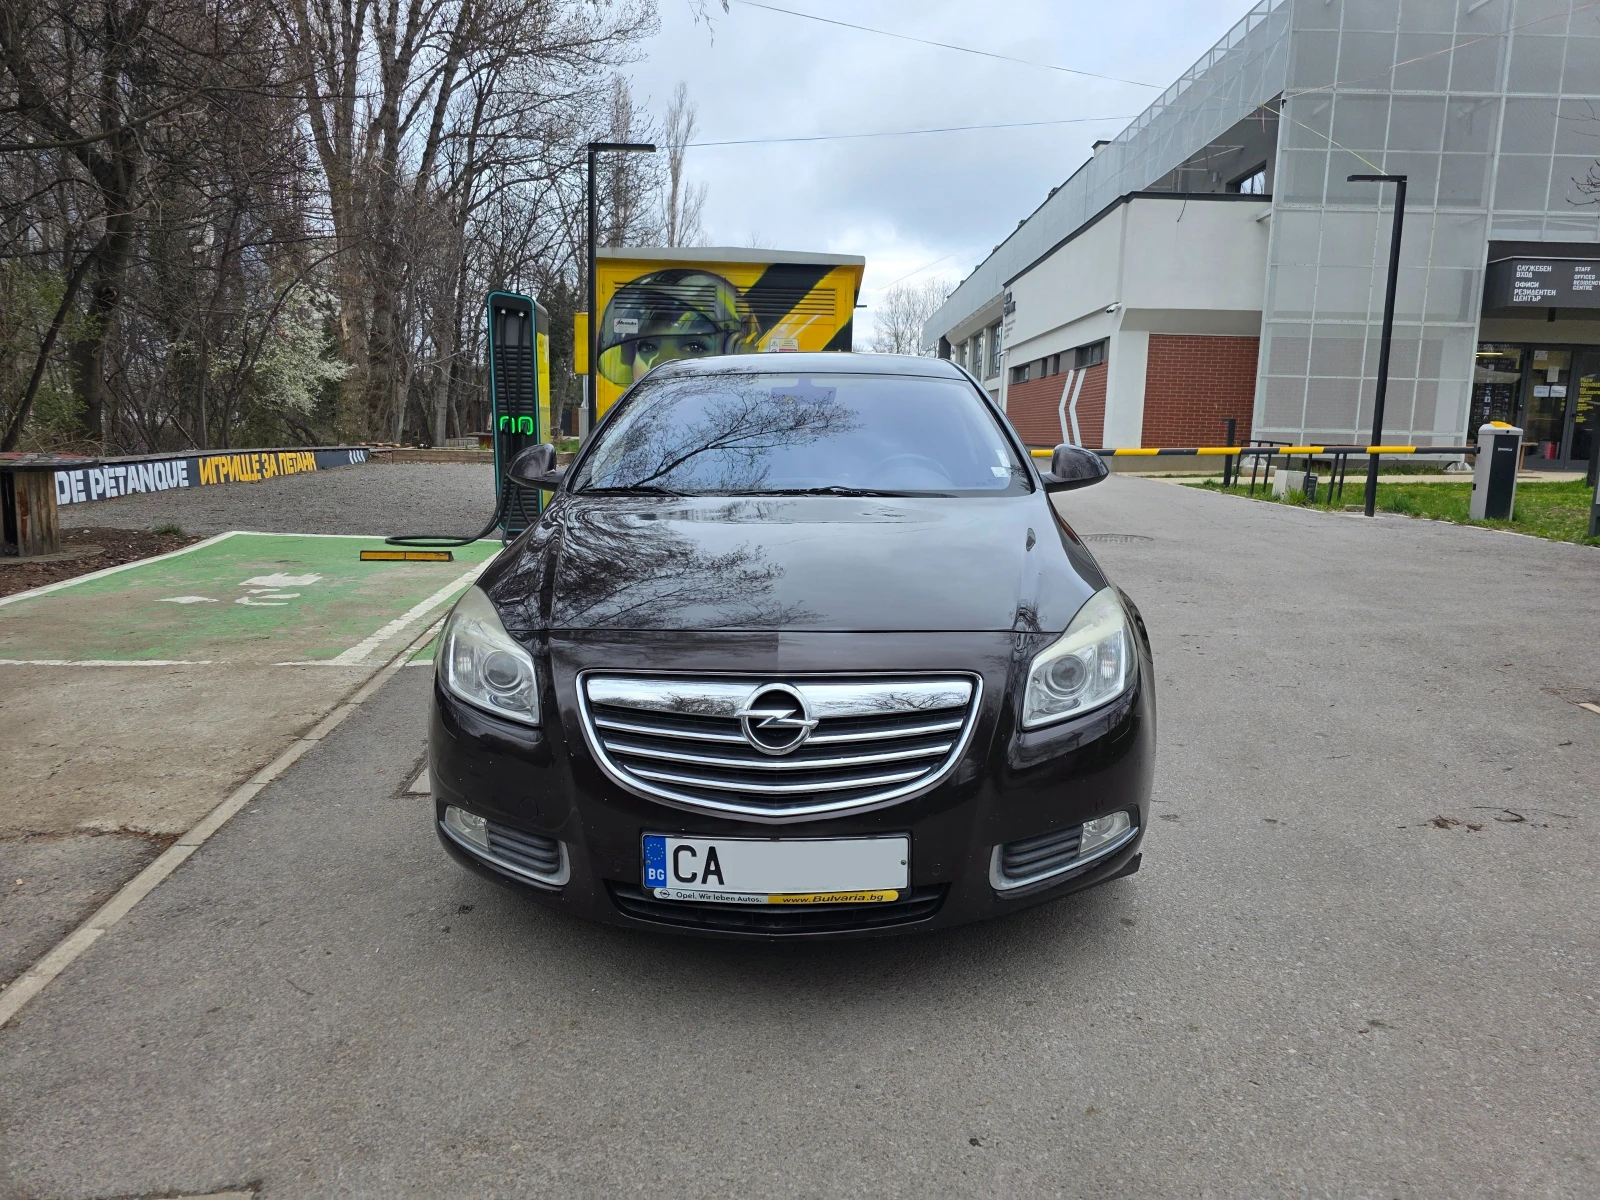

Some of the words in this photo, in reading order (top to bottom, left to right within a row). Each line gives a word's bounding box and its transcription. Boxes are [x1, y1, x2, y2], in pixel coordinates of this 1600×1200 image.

[1514, 288, 1557, 296] РЕЗИДЕНТЕН
[198, 453, 262, 486] ИГРИЩЕ
[261, 452, 279, 479] ЗА
[278, 451, 317, 476] ПЕТАНК
[54, 469, 87, 506] DE
[648, 867, 665, 881] BG
[672, 844, 725, 886] CA
[676, 891, 697, 900] Opel.
[698, 892, 712, 901] Wir
[713, 893, 736, 902] leben
[737, 895, 762, 903] Autos.
